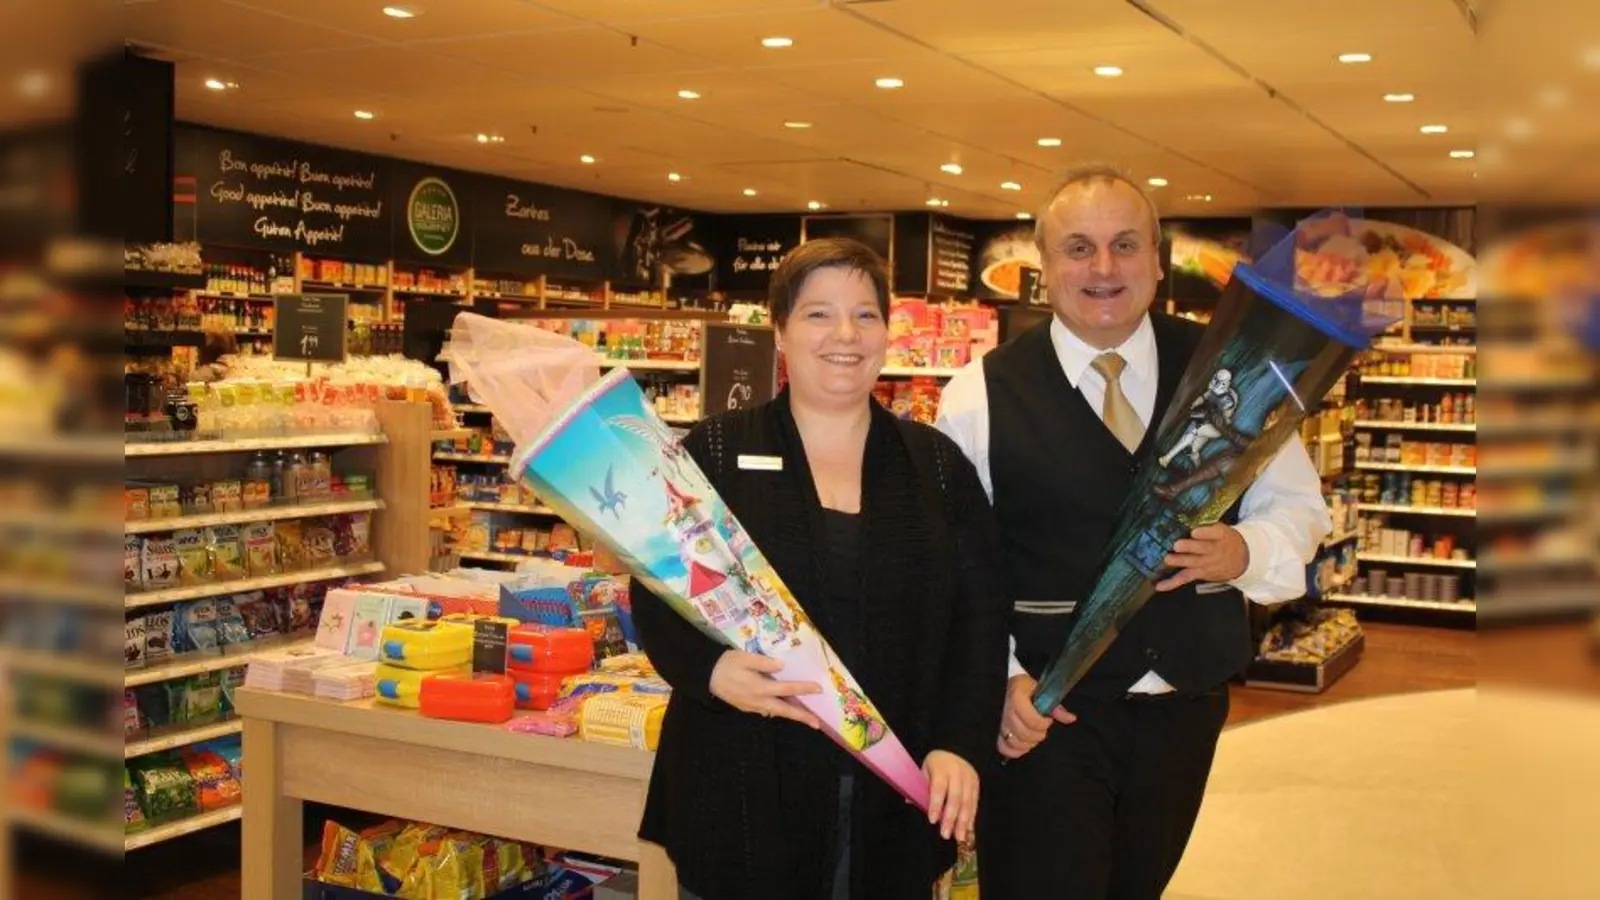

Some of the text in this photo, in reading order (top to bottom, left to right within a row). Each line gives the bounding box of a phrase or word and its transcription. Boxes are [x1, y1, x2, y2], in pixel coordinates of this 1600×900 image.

[220, 149, 248, 173] Bon
[210, 180, 244, 203] Good
[415, 201, 453, 222] GALERIA
[254, 216, 292, 239] Guten
[562, 237, 595, 262] Dose
